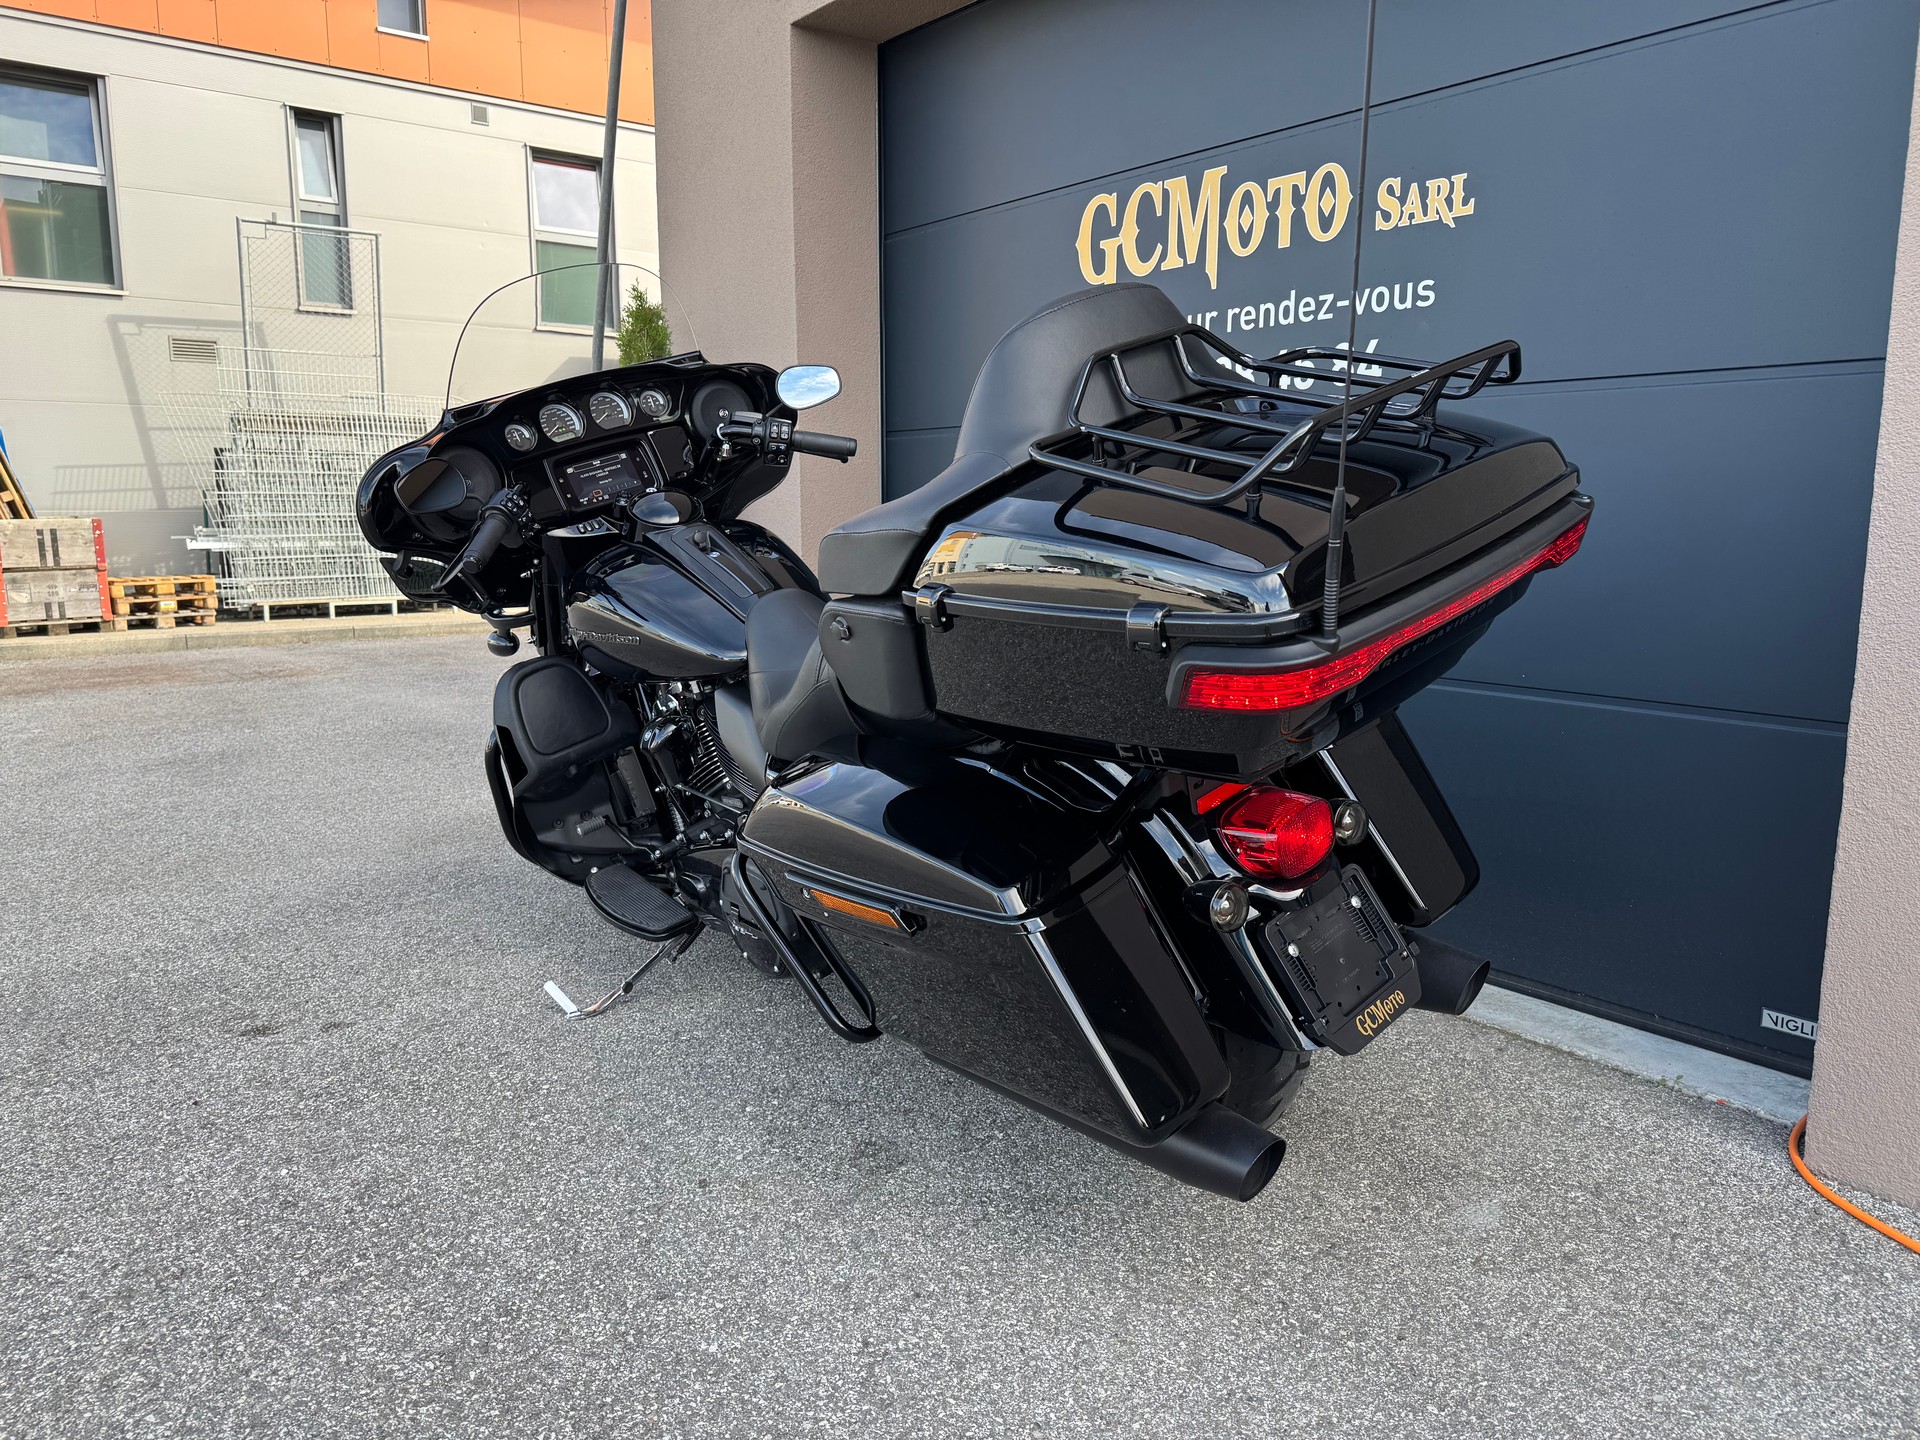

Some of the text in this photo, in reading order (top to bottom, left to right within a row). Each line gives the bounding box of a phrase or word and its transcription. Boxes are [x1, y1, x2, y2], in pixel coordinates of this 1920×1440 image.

[1375, 173, 1475, 231] SARL
[1227, 279, 1436, 333] rendez-vous
[1767, 1012, 1818, 1038] VIGLI
